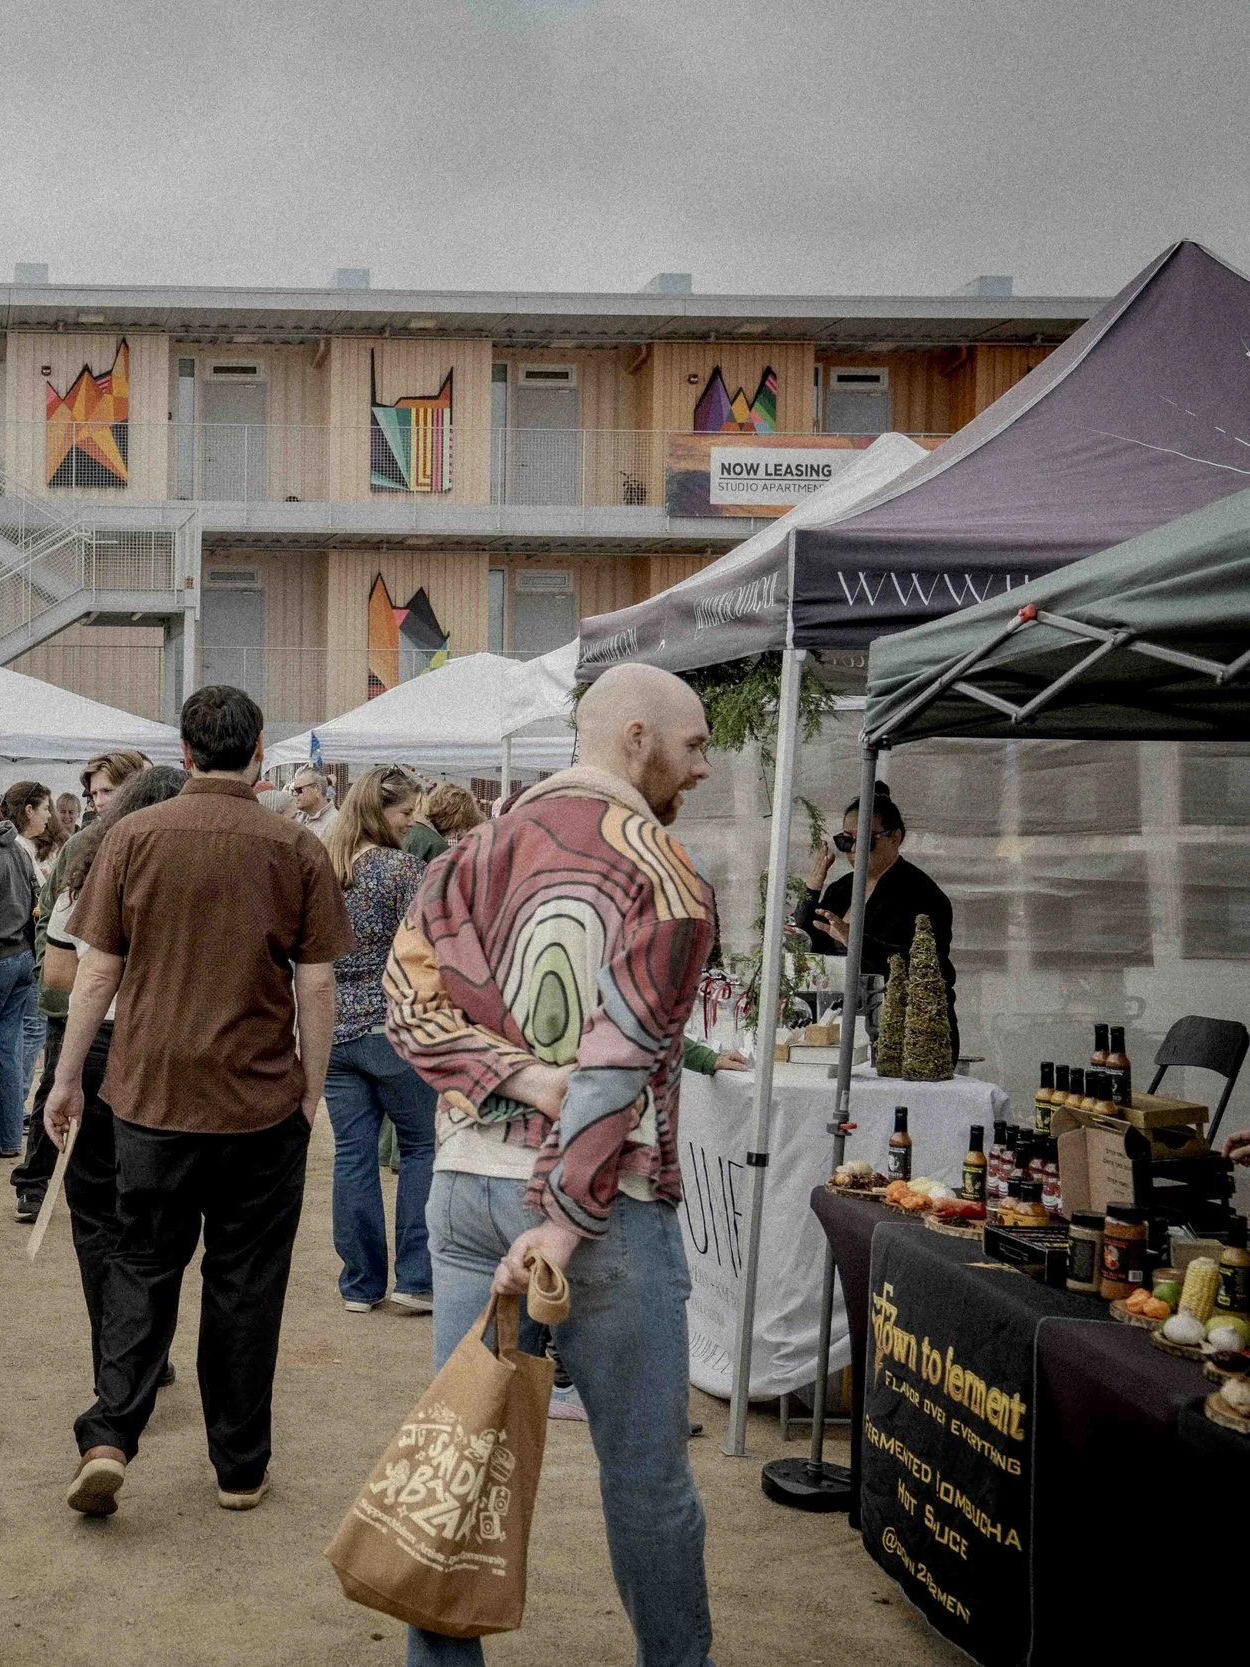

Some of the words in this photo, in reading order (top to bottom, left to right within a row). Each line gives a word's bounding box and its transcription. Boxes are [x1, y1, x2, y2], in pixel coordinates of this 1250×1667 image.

[718, 482, 758, 492] STUDIO
[761, 482, 824, 493] APARTMEN
[721, 463, 760, 476] NOW
[765, 463, 832, 477] LEASING
[921, 1336, 942, 1385] to
[885, 1370, 920, 1409] FLAVOR
[898, 1478, 918, 1516] HOT
[924, 1503, 969, 1560] SUCE
